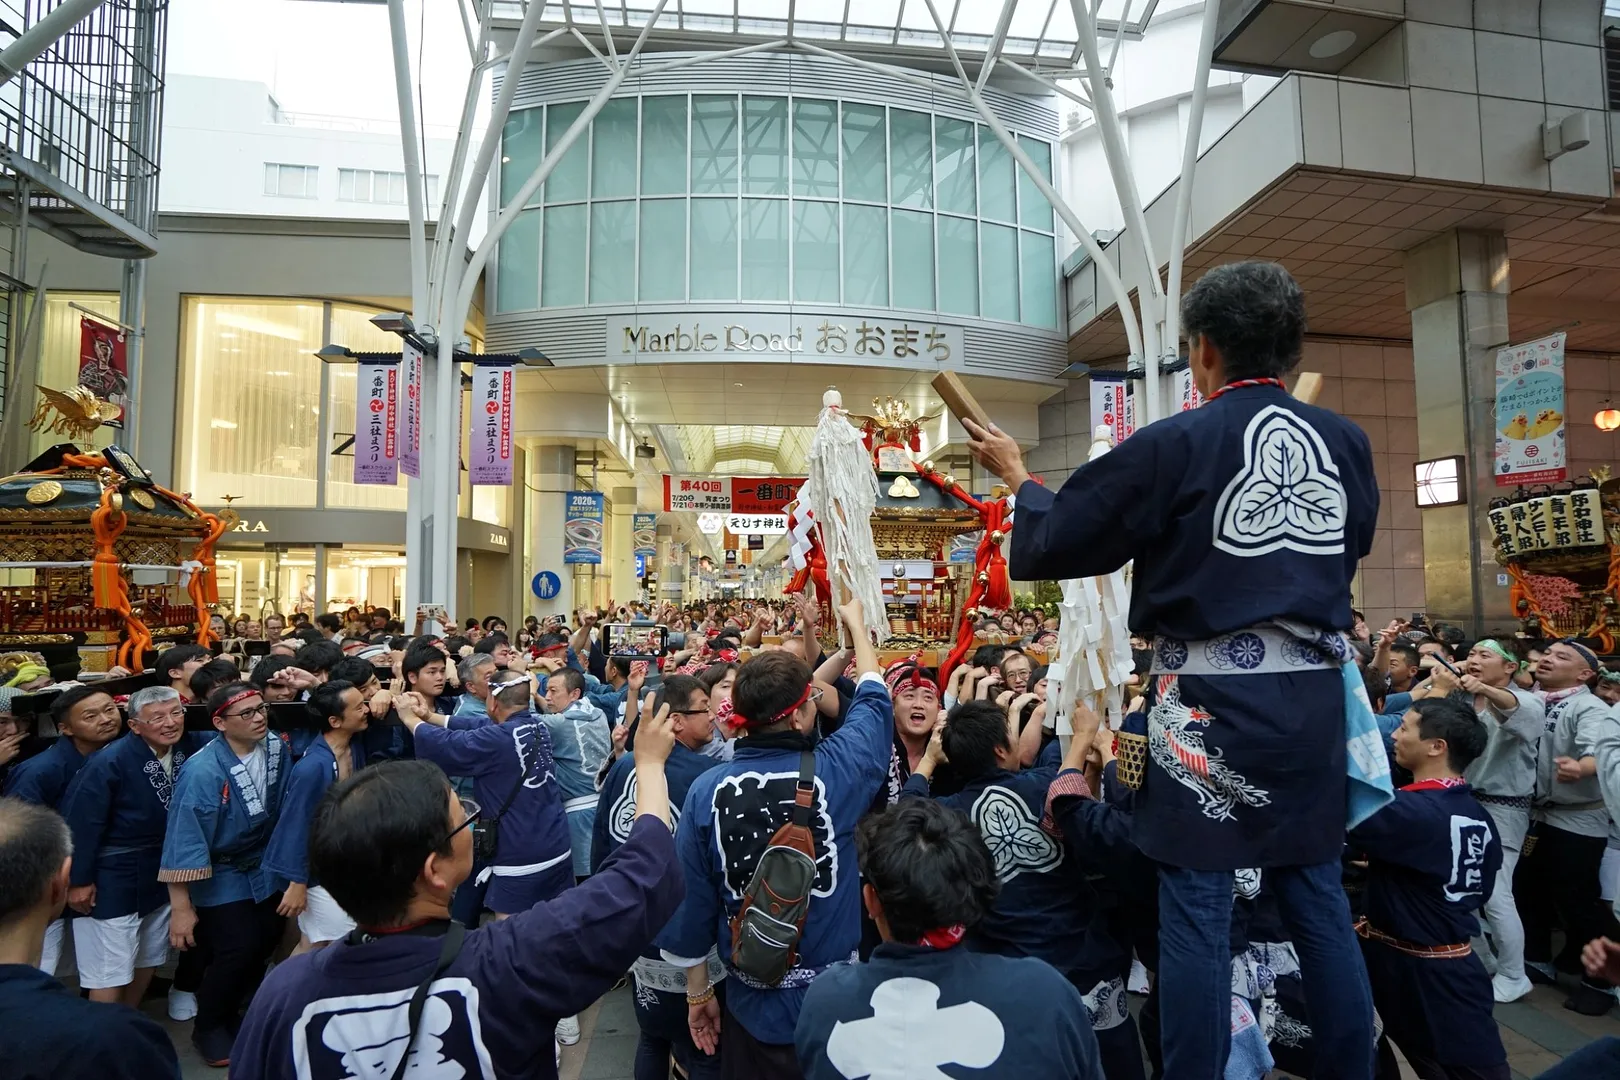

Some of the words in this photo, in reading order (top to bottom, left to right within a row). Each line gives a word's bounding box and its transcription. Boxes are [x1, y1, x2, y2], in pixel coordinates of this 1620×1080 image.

[622, 323, 718, 353] Marble
[723, 325, 804, 353] Road
[816, 319, 951, 361] おおまち
[371, 369, 384, 398] 一番町
[487, 371, 499, 400] 一番町
[370, 414, 382, 463] 三社まつり
[486, 416, 498, 464] 三社まつり
[680, 480, 722, 493] 第40回
[738, 482, 801, 501] 一番町
[1511, 506, 1534, 549] 婦人部
[1528, 500, 1550, 548] サンモール
[1550, 497, 1571, 545] 青年部
[1570, 493, 1596, 542] 野中神社
[490, 533, 507, 546] ZARA
